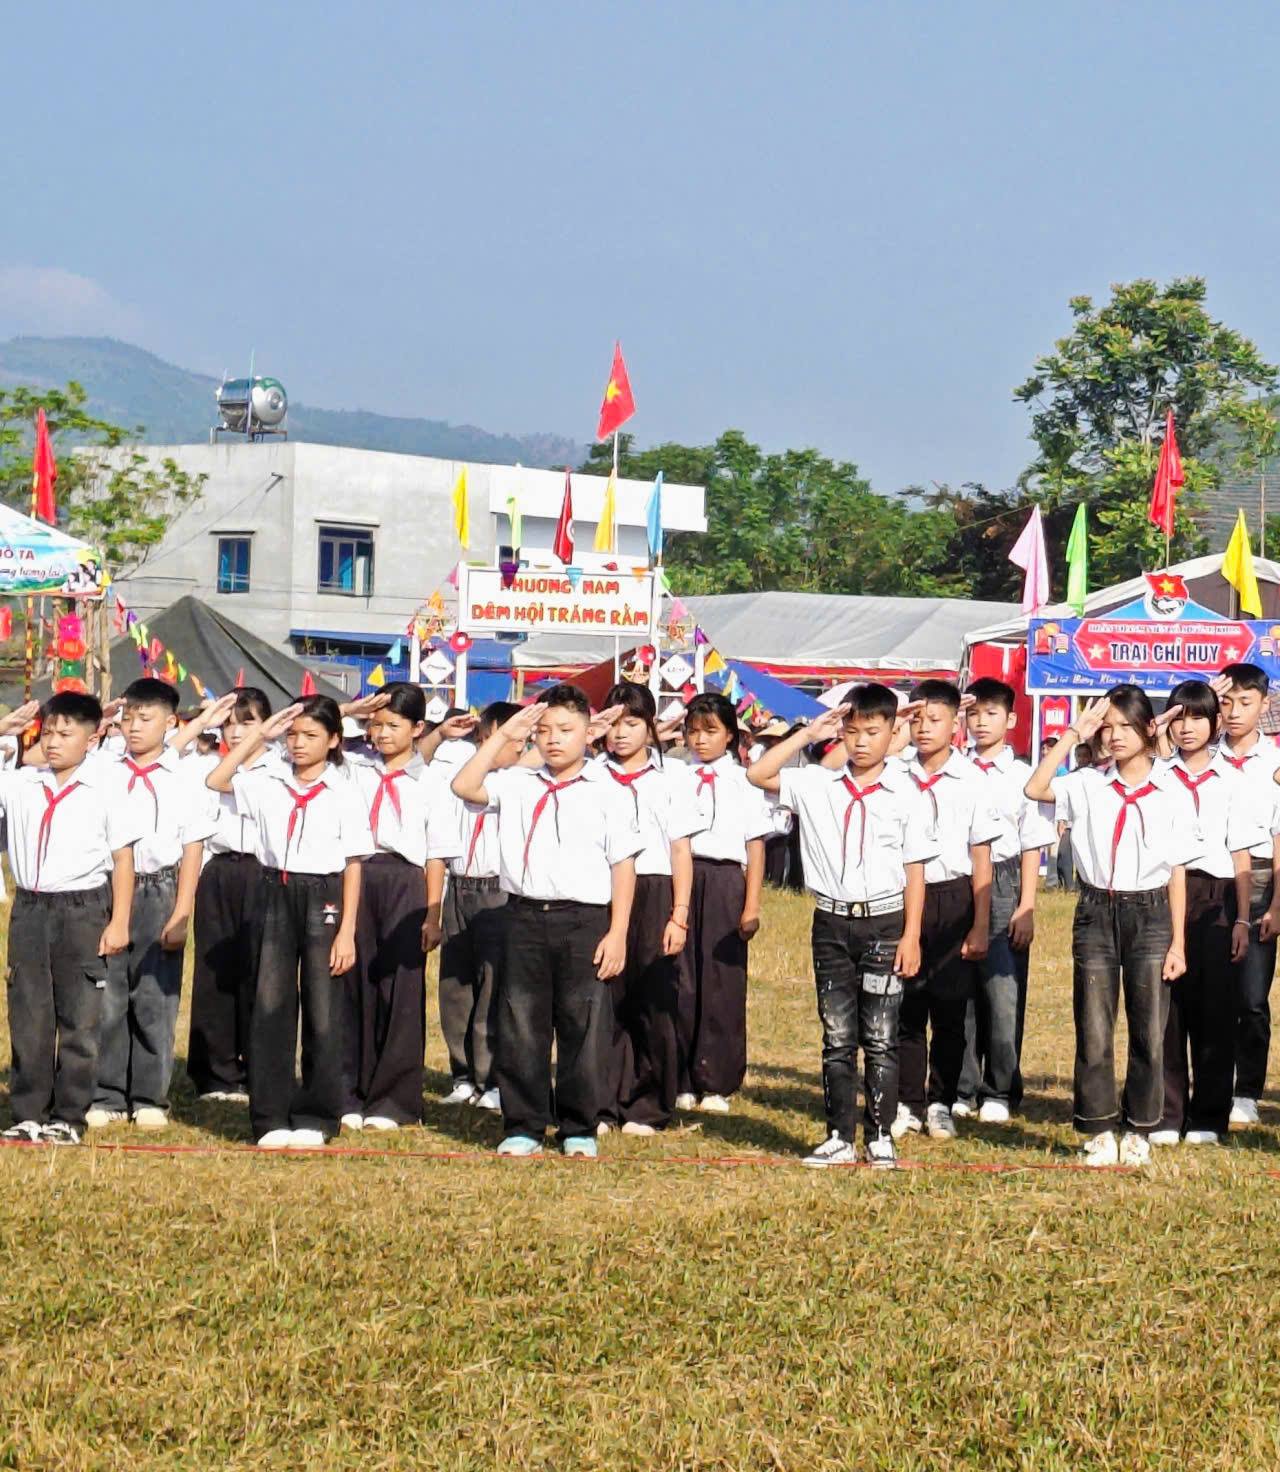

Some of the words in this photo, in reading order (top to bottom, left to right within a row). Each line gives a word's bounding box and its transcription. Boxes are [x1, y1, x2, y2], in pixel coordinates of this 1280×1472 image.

[582, 579, 620, 595] NAM
[1110, 643, 1147, 665] TRẠI
[1152, 637, 1181, 662] CHỈ
[1187, 644, 1219, 663] HUY
